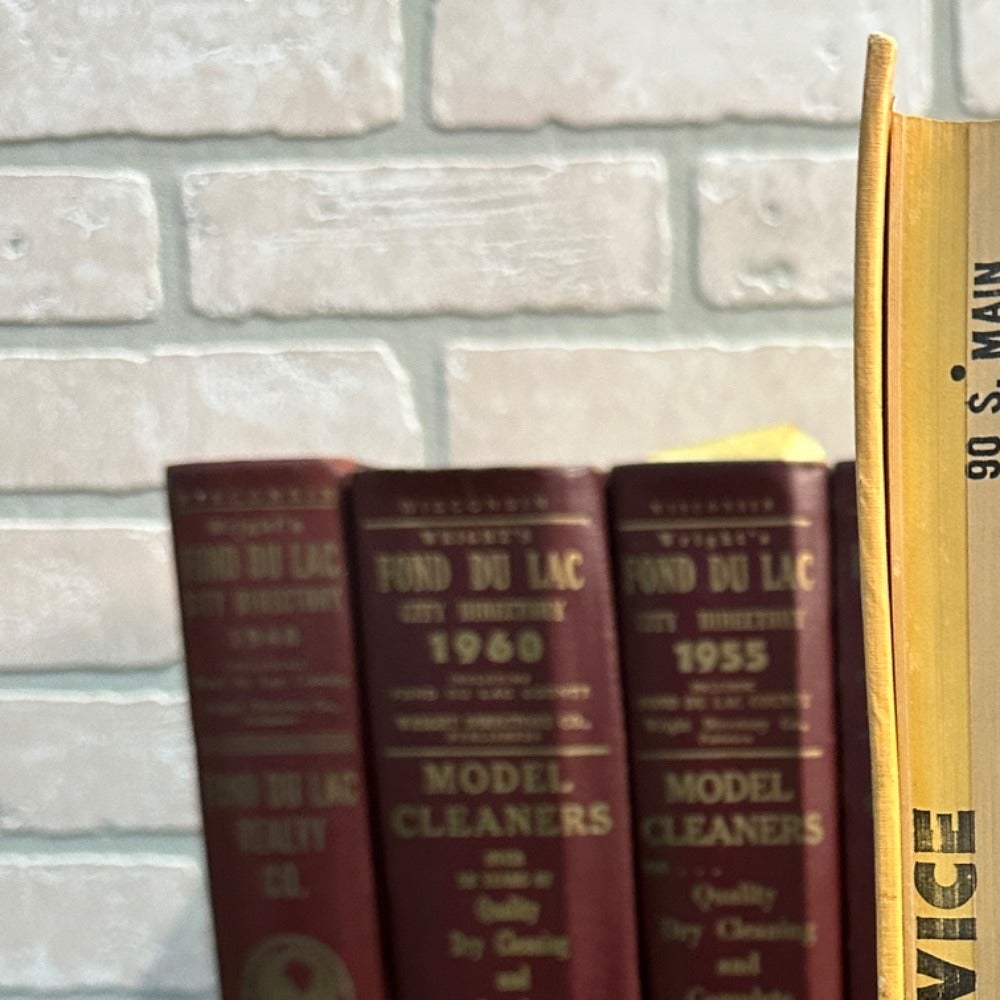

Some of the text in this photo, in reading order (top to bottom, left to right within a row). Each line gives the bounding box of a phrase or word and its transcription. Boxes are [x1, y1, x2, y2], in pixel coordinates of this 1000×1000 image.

[708, 552, 750, 593] DU
[759, 549, 816, 592] LAC
[427, 629, 544, 665] 1960
[671, 637, 770, 674] 1955
[421, 761, 576, 795] MODEL
[663, 768, 795, 804] MODEL
[389, 801, 614, 839] CLEANERS
[640, 809, 825, 849] CLEANERS
